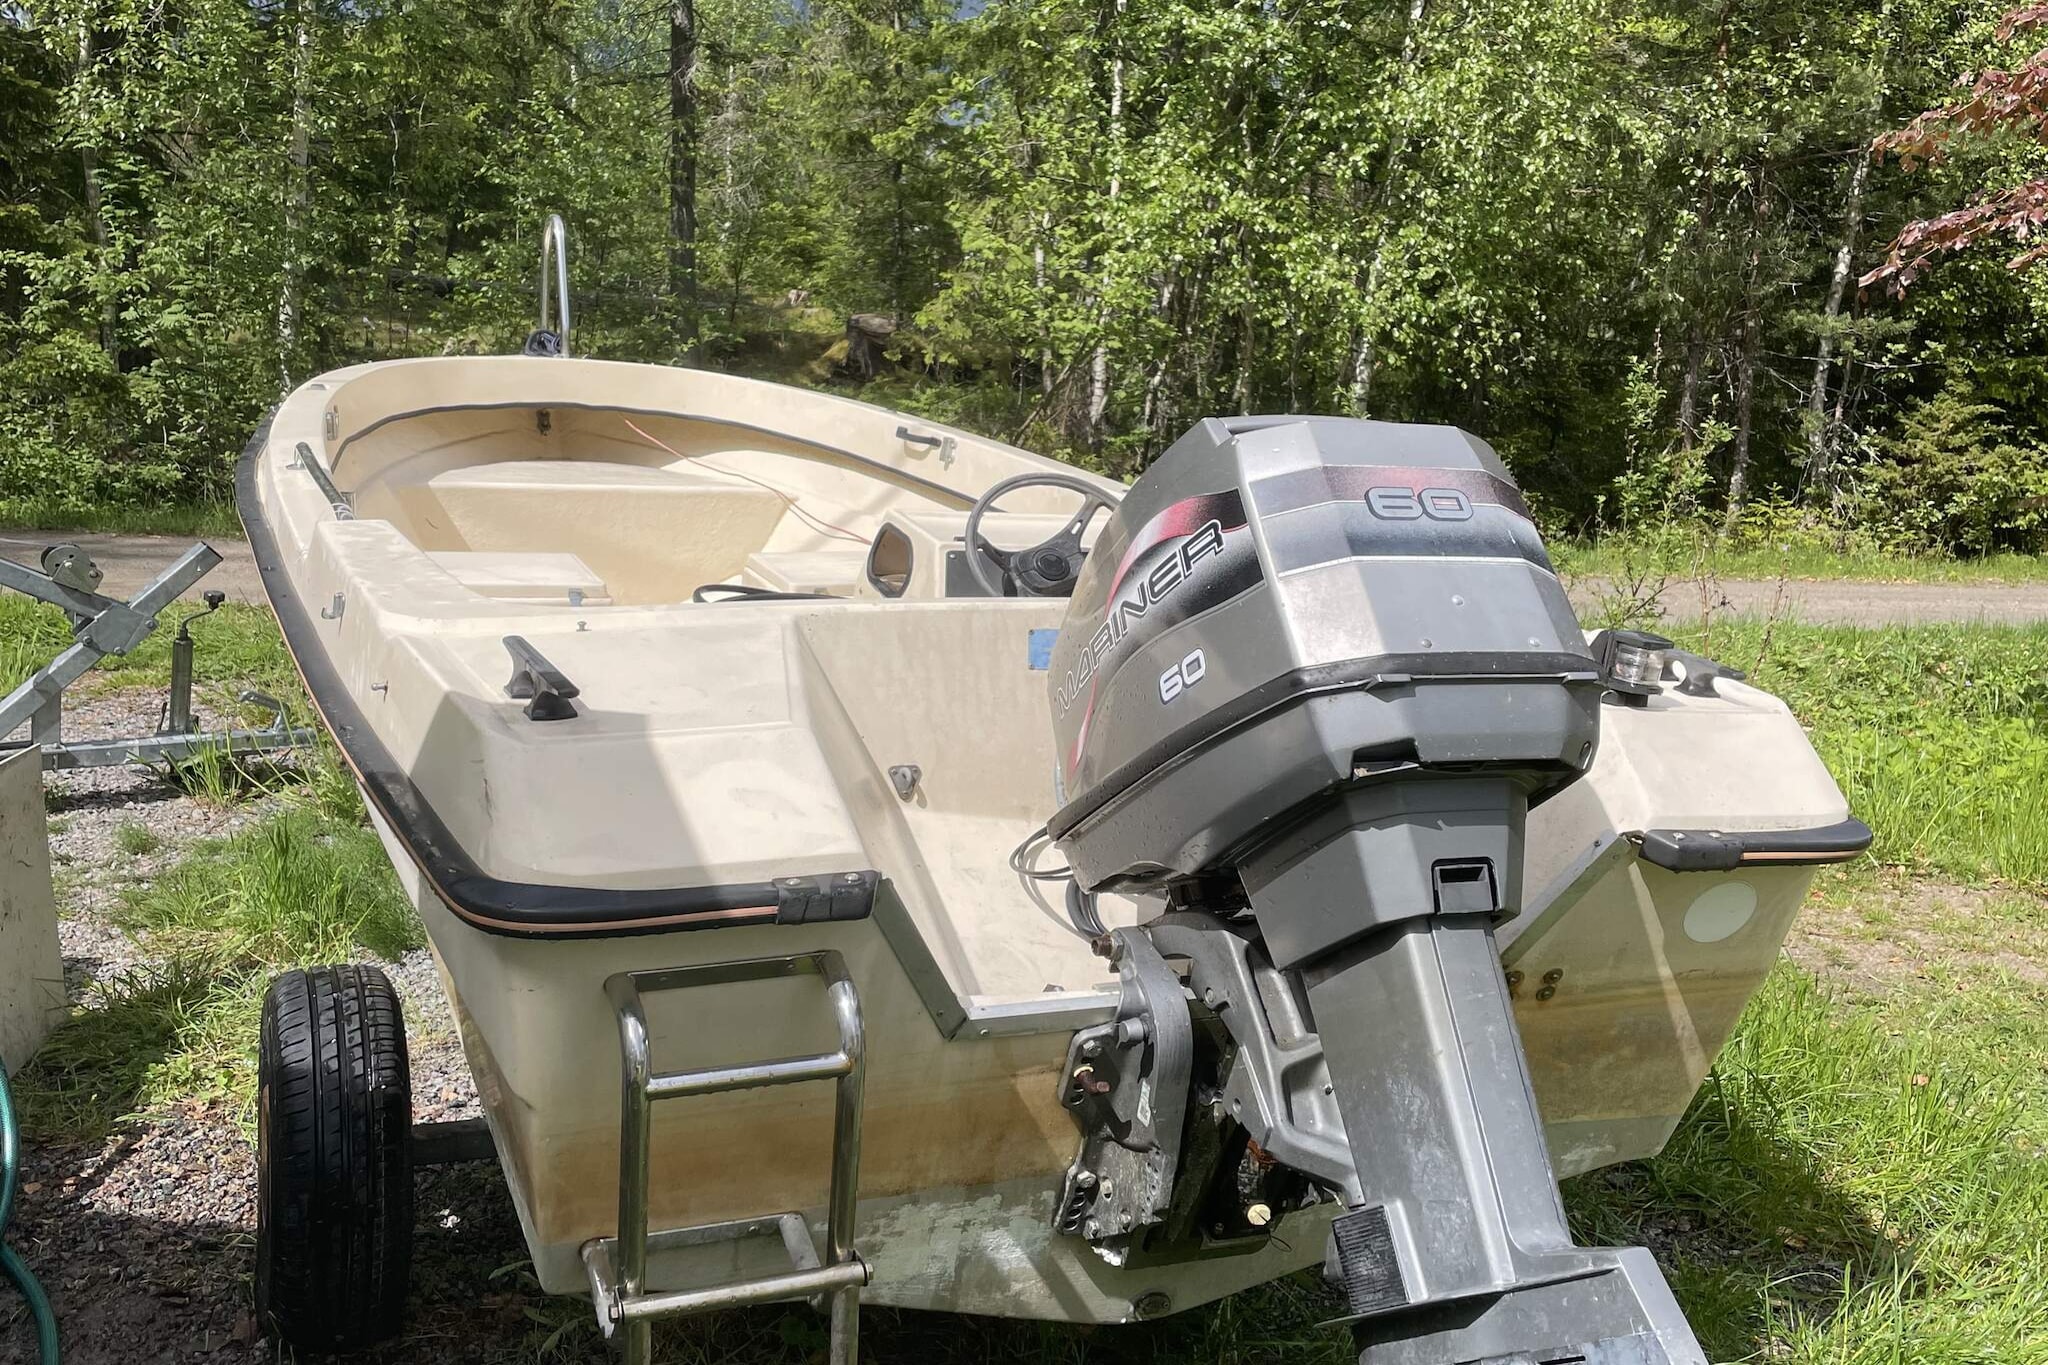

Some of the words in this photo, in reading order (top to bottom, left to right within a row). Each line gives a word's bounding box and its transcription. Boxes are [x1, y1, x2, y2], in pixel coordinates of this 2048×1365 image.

[1364, 487, 1474, 521] 60
[1056, 519, 1225, 719] MARINER
[1159, 648, 1206, 705] 60
